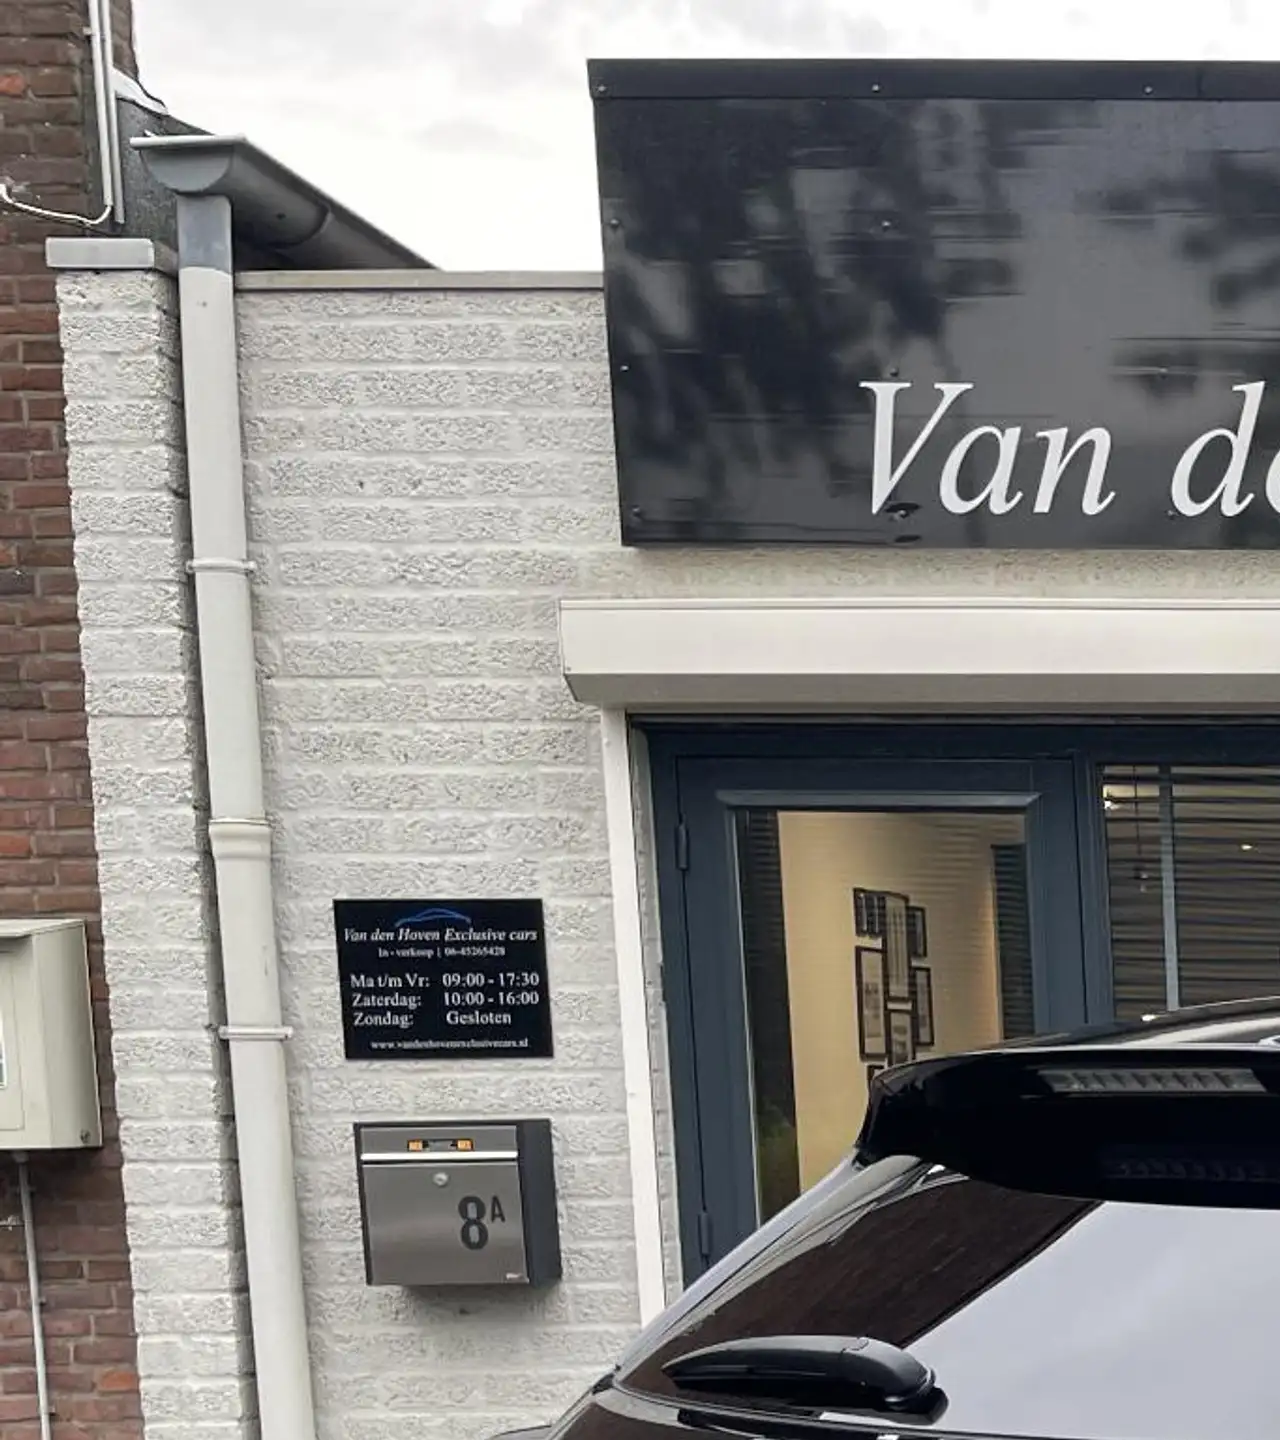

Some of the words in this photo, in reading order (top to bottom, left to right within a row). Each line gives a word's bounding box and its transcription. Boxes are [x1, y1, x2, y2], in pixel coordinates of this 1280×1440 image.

[860, 380, 1116, 516] Van
[344, 928, 367, 942] Van
[370, 928, 394, 941] den
[398, 928, 440, 941] Hoven
[444, 927, 506, 942] Exclusive
[509, 930, 538, 941] cars
[350, 974, 374, 988] Ma
[377, 974, 402, 987] t/m
[406, 973, 430, 987] Vr:
[442, 973, 484, 987] 09:00
[498, 972, 540, 987] 17:30
[352, 993, 422, 1010] Zaterdag:
[444, 992, 484, 1006] 10:00
[498, 991, 539, 1005] 16:00
[354, 1012, 414, 1029] Zondag:
[446, 1011, 512, 1026] Gesloten
